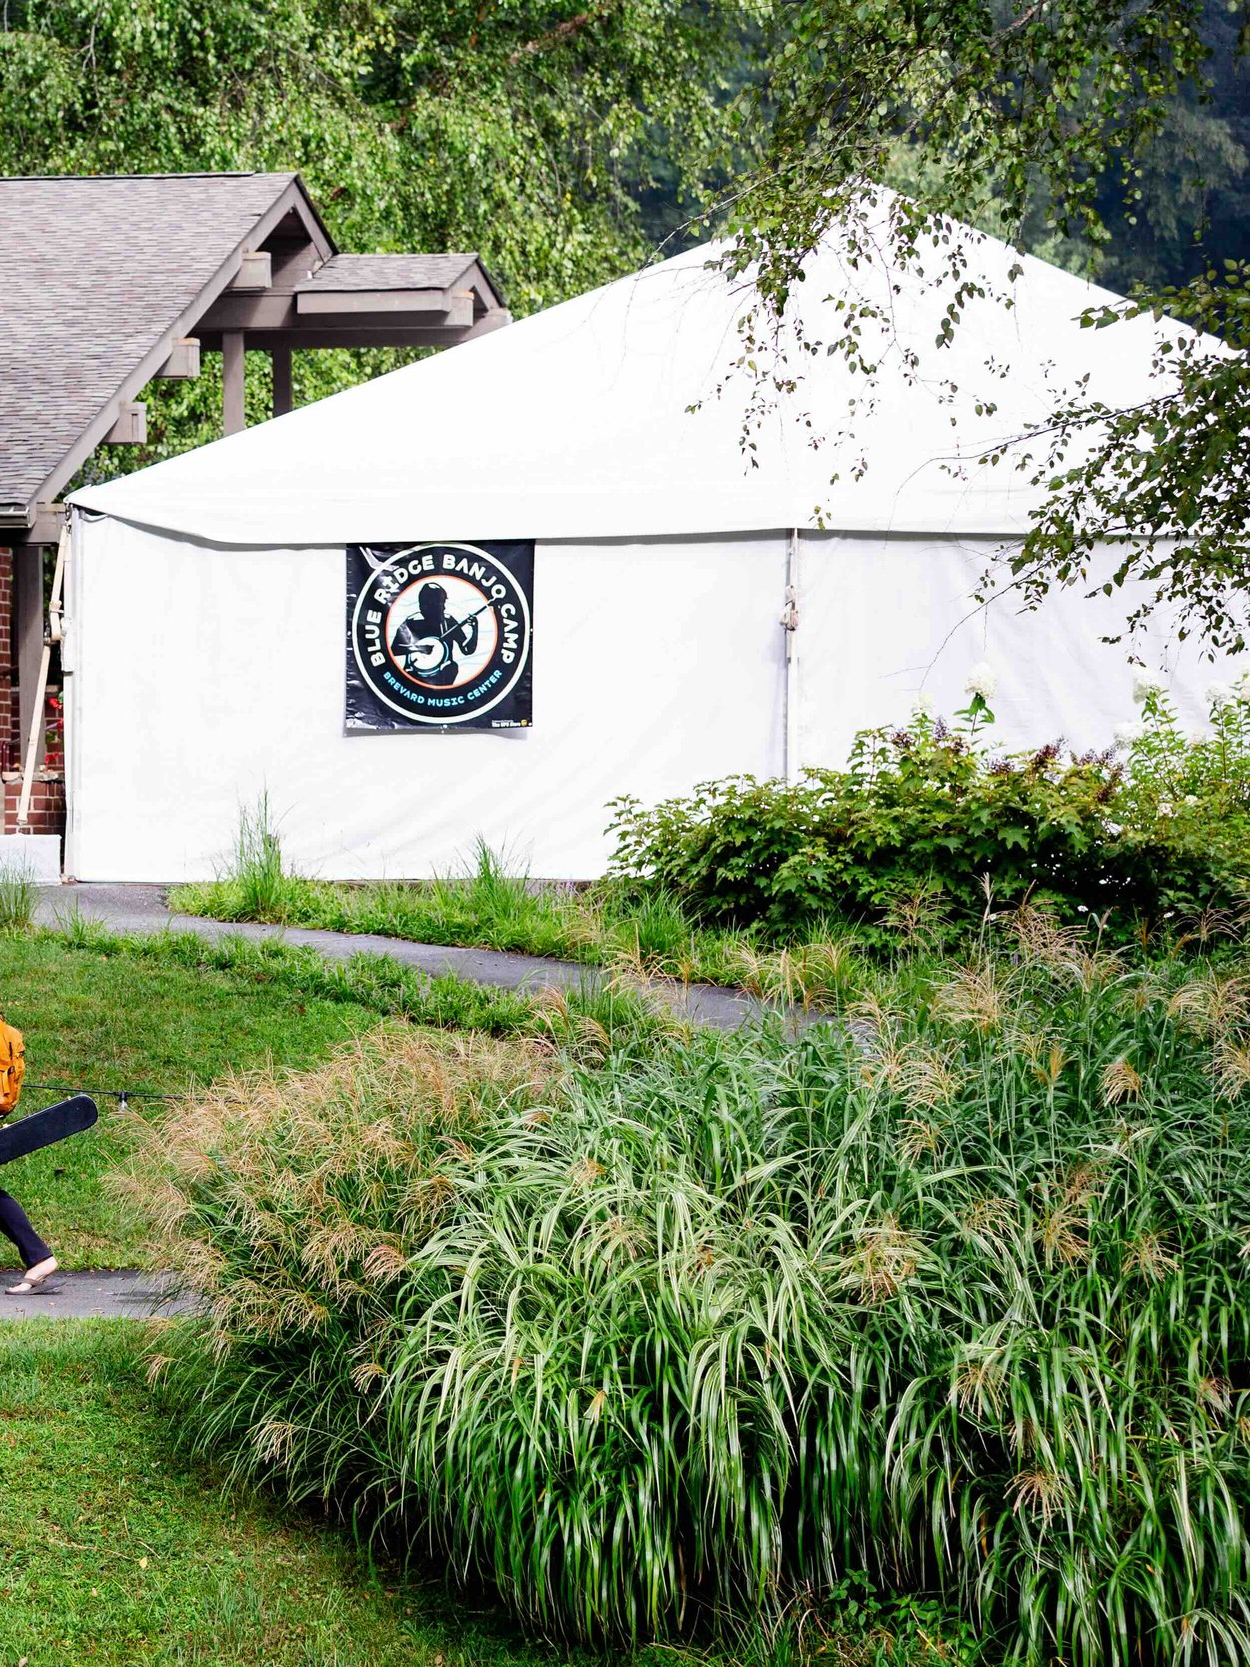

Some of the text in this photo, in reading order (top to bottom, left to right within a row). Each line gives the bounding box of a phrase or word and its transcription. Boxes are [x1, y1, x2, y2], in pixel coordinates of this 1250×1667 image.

[365, 554, 519, 667] BLUE RIDGE BANJO CAMP
[383, 669, 502, 707] BREVARD MUSIC CENTER
